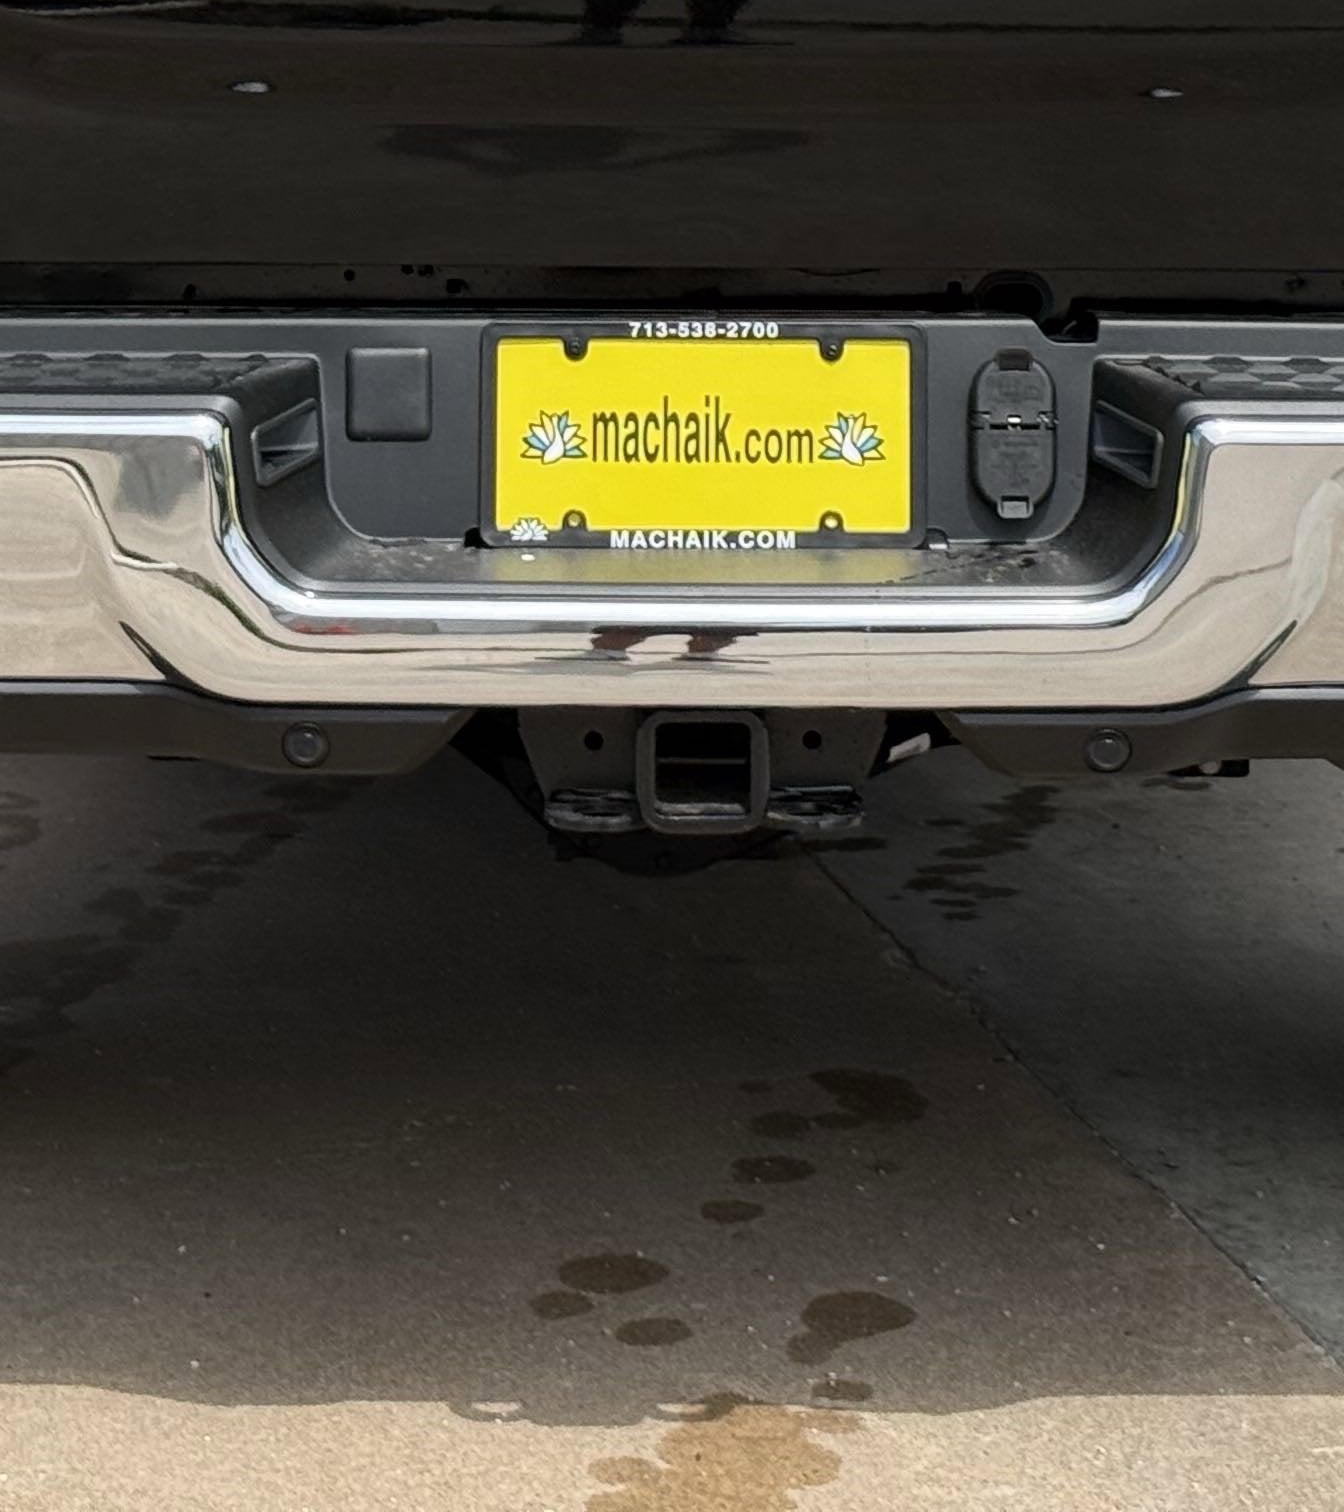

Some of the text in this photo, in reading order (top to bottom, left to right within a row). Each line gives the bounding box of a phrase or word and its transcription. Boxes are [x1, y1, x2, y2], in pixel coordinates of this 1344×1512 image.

[628, 321, 779, 339] 713-538-2700
[591, 395, 815, 464] machaik.com
[609, 530, 796, 550] MACHAIK.COM
